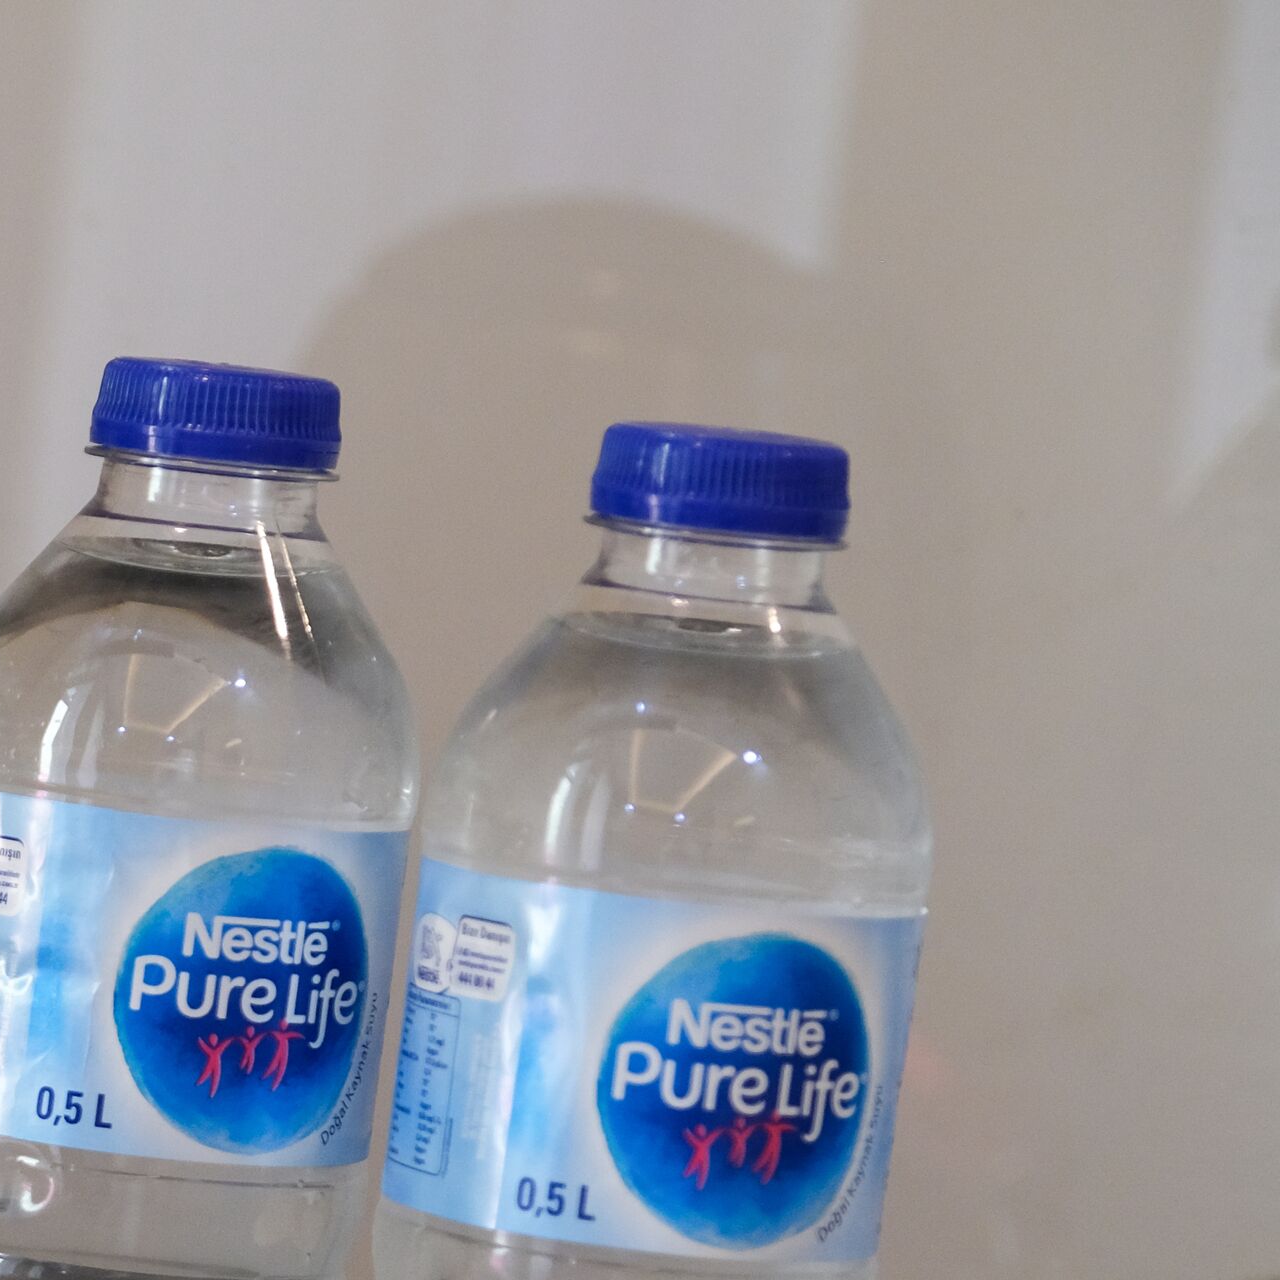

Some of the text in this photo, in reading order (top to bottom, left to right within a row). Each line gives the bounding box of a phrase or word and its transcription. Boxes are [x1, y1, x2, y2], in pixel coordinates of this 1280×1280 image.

[182, 911, 331, 966] Nestlé
[128, 954, 359, 1049] Pure Life
[665, 998, 828, 1057] Nestlé
[320, 992, 378, 1146] Doğal Kaynak Suyu
[610, 1041, 861, 1143] Pure Life
[35, 1085, 113, 1129] 0,5 L
[515, 1176, 596, 1221] 0,5 L
